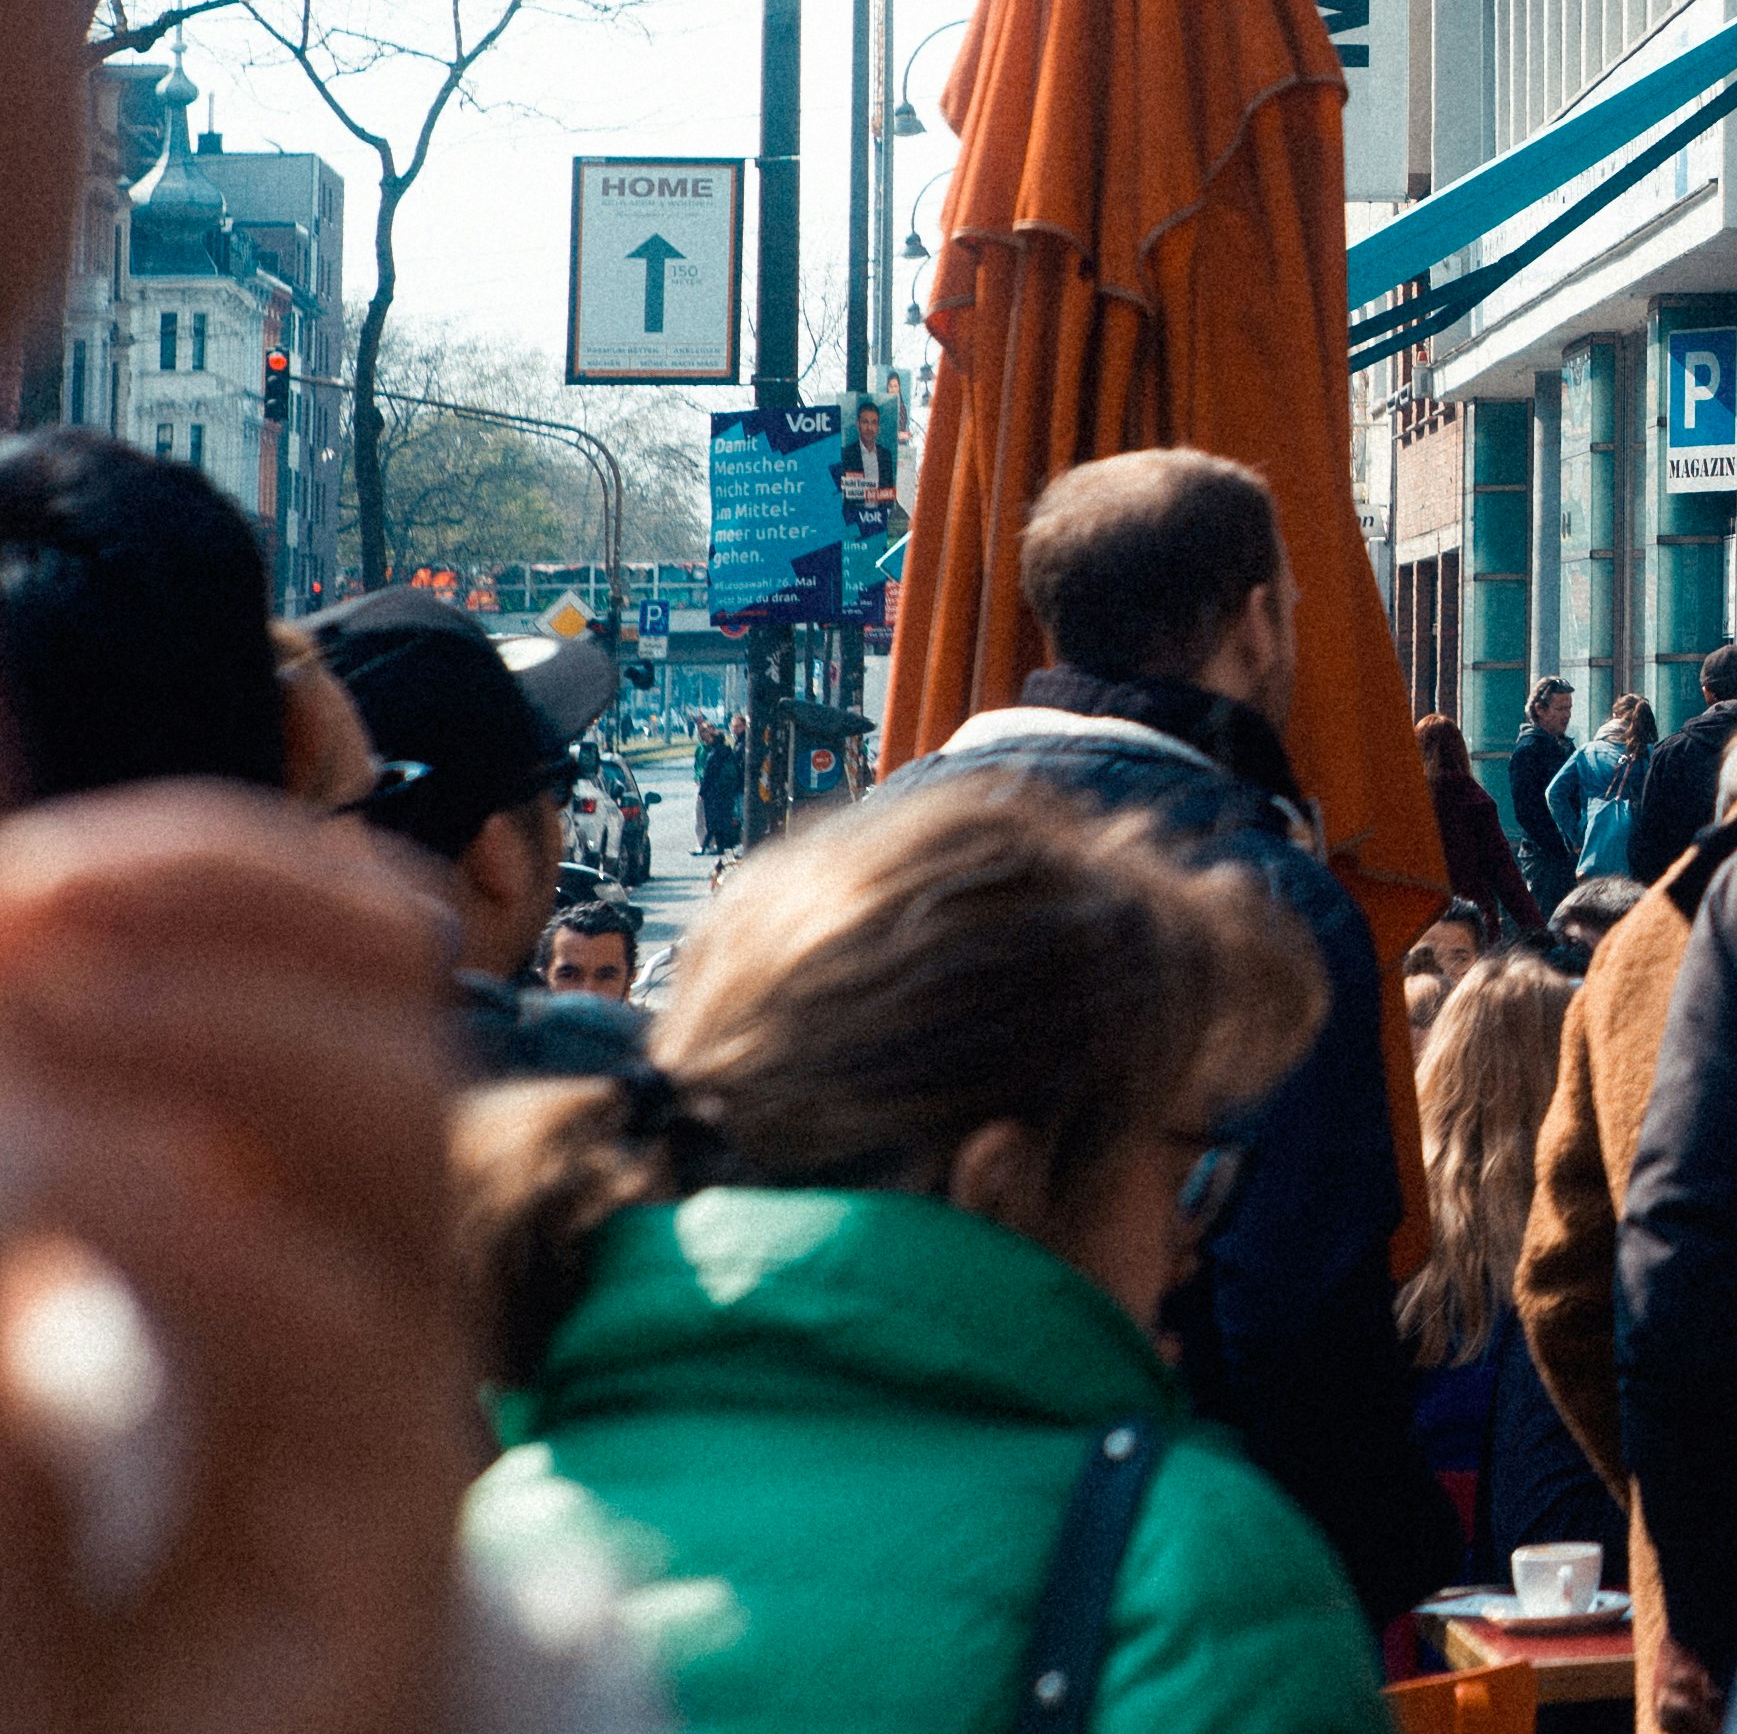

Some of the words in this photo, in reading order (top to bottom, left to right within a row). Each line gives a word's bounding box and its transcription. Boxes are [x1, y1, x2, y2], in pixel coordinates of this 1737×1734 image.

[602, 176, 713, 198] HOME
[671, 266, 698, 278] 150
[1684, 351, 1721, 429] P
[785, 412, 831, 433] Volt
[715, 434, 758, 454] Damit
[714, 456, 798, 475] Menschen
[1669, 456, 1736, 479] MAGAZIN
[715, 480, 750, 498] nicht
[755, 477, 805, 494] mehr
[716, 504, 732, 520] im
[735, 499, 796, 520] Mittel-
[858, 510, 883, 524] Volt
[715, 528, 751, 543] meer
[755, 524, 817, 540] unter-
[843, 541, 868, 551] lima
[713, 547, 765, 569] gehen.
[795, 575, 817, 588] Mai
[756, 594, 769, 603] du
[771, 593, 800, 603] dran.
[646, 605, 663, 630] P
